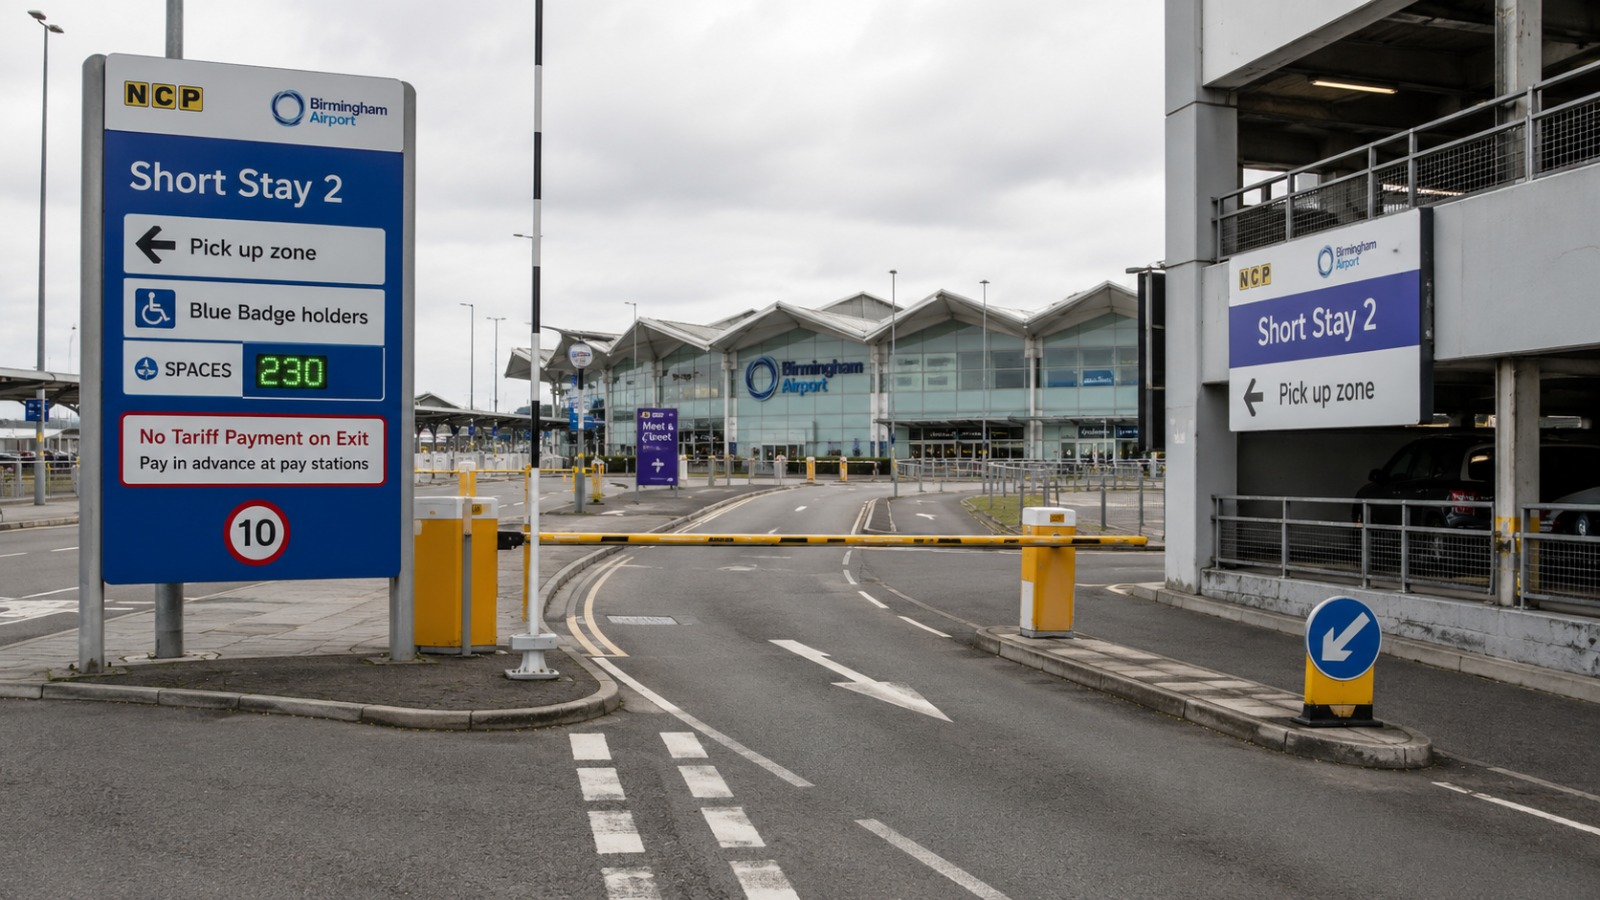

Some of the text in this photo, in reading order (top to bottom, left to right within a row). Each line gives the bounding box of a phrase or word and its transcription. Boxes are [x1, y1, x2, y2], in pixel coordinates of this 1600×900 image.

[126, 83, 201, 109] NCP
[310, 97, 388, 116] Birmingham
[309, 111, 357, 127] Airport
[129, 160, 343, 208] Short Stay 2
[190, 238, 317, 262] Pick up zone
[1336, 241, 1378, 258] Birmingham
[1336, 256, 1360, 271] Airport
[1240, 265, 1270, 289] NCP
[190, 302, 369, 325] Blue Badge holders
[1258, 297, 1377, 346] Short Stay 2
[164, 362, 232, 378] SPACES
[260, 357, 323, 386] 230
[782, 359, 864, 378] Birmingham
[782, 378, 828, 396] Airport
[1279, 380, 1375, 408] Pick up zone
[642, 421, 665, 431] Meet
[140, 428, 369, 449] No Tariff Payment on Exit
[140, 456, 369, 473] Pay in advance at pay stations
[238, 518, 277, 547] 10
